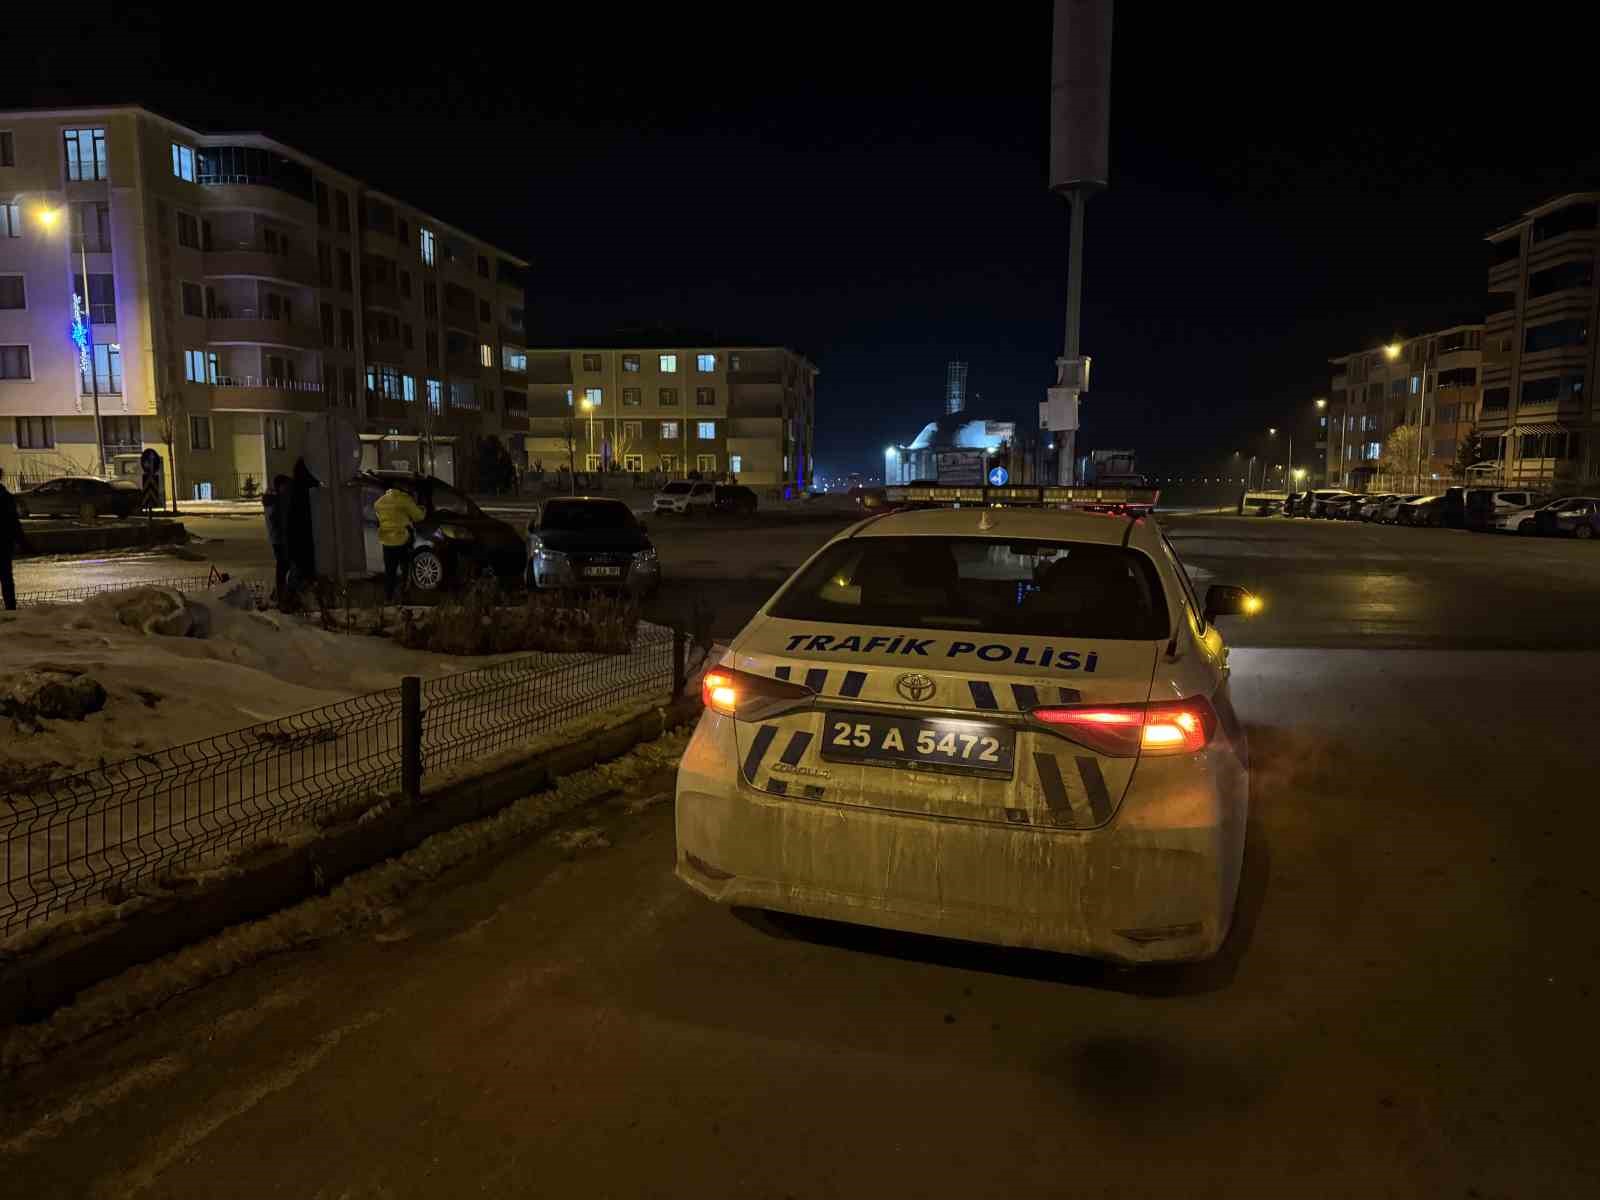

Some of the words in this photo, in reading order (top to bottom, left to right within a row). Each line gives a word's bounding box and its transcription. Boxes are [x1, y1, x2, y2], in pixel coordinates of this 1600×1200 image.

[786, 635, 936, 656] TRAFİK
[947, 641, 1099, 672] POLİSİ
[832, 722, 872, 748] 25
[882, 728, 906, 752] A
[916, 731, 1000, 761] 5472
